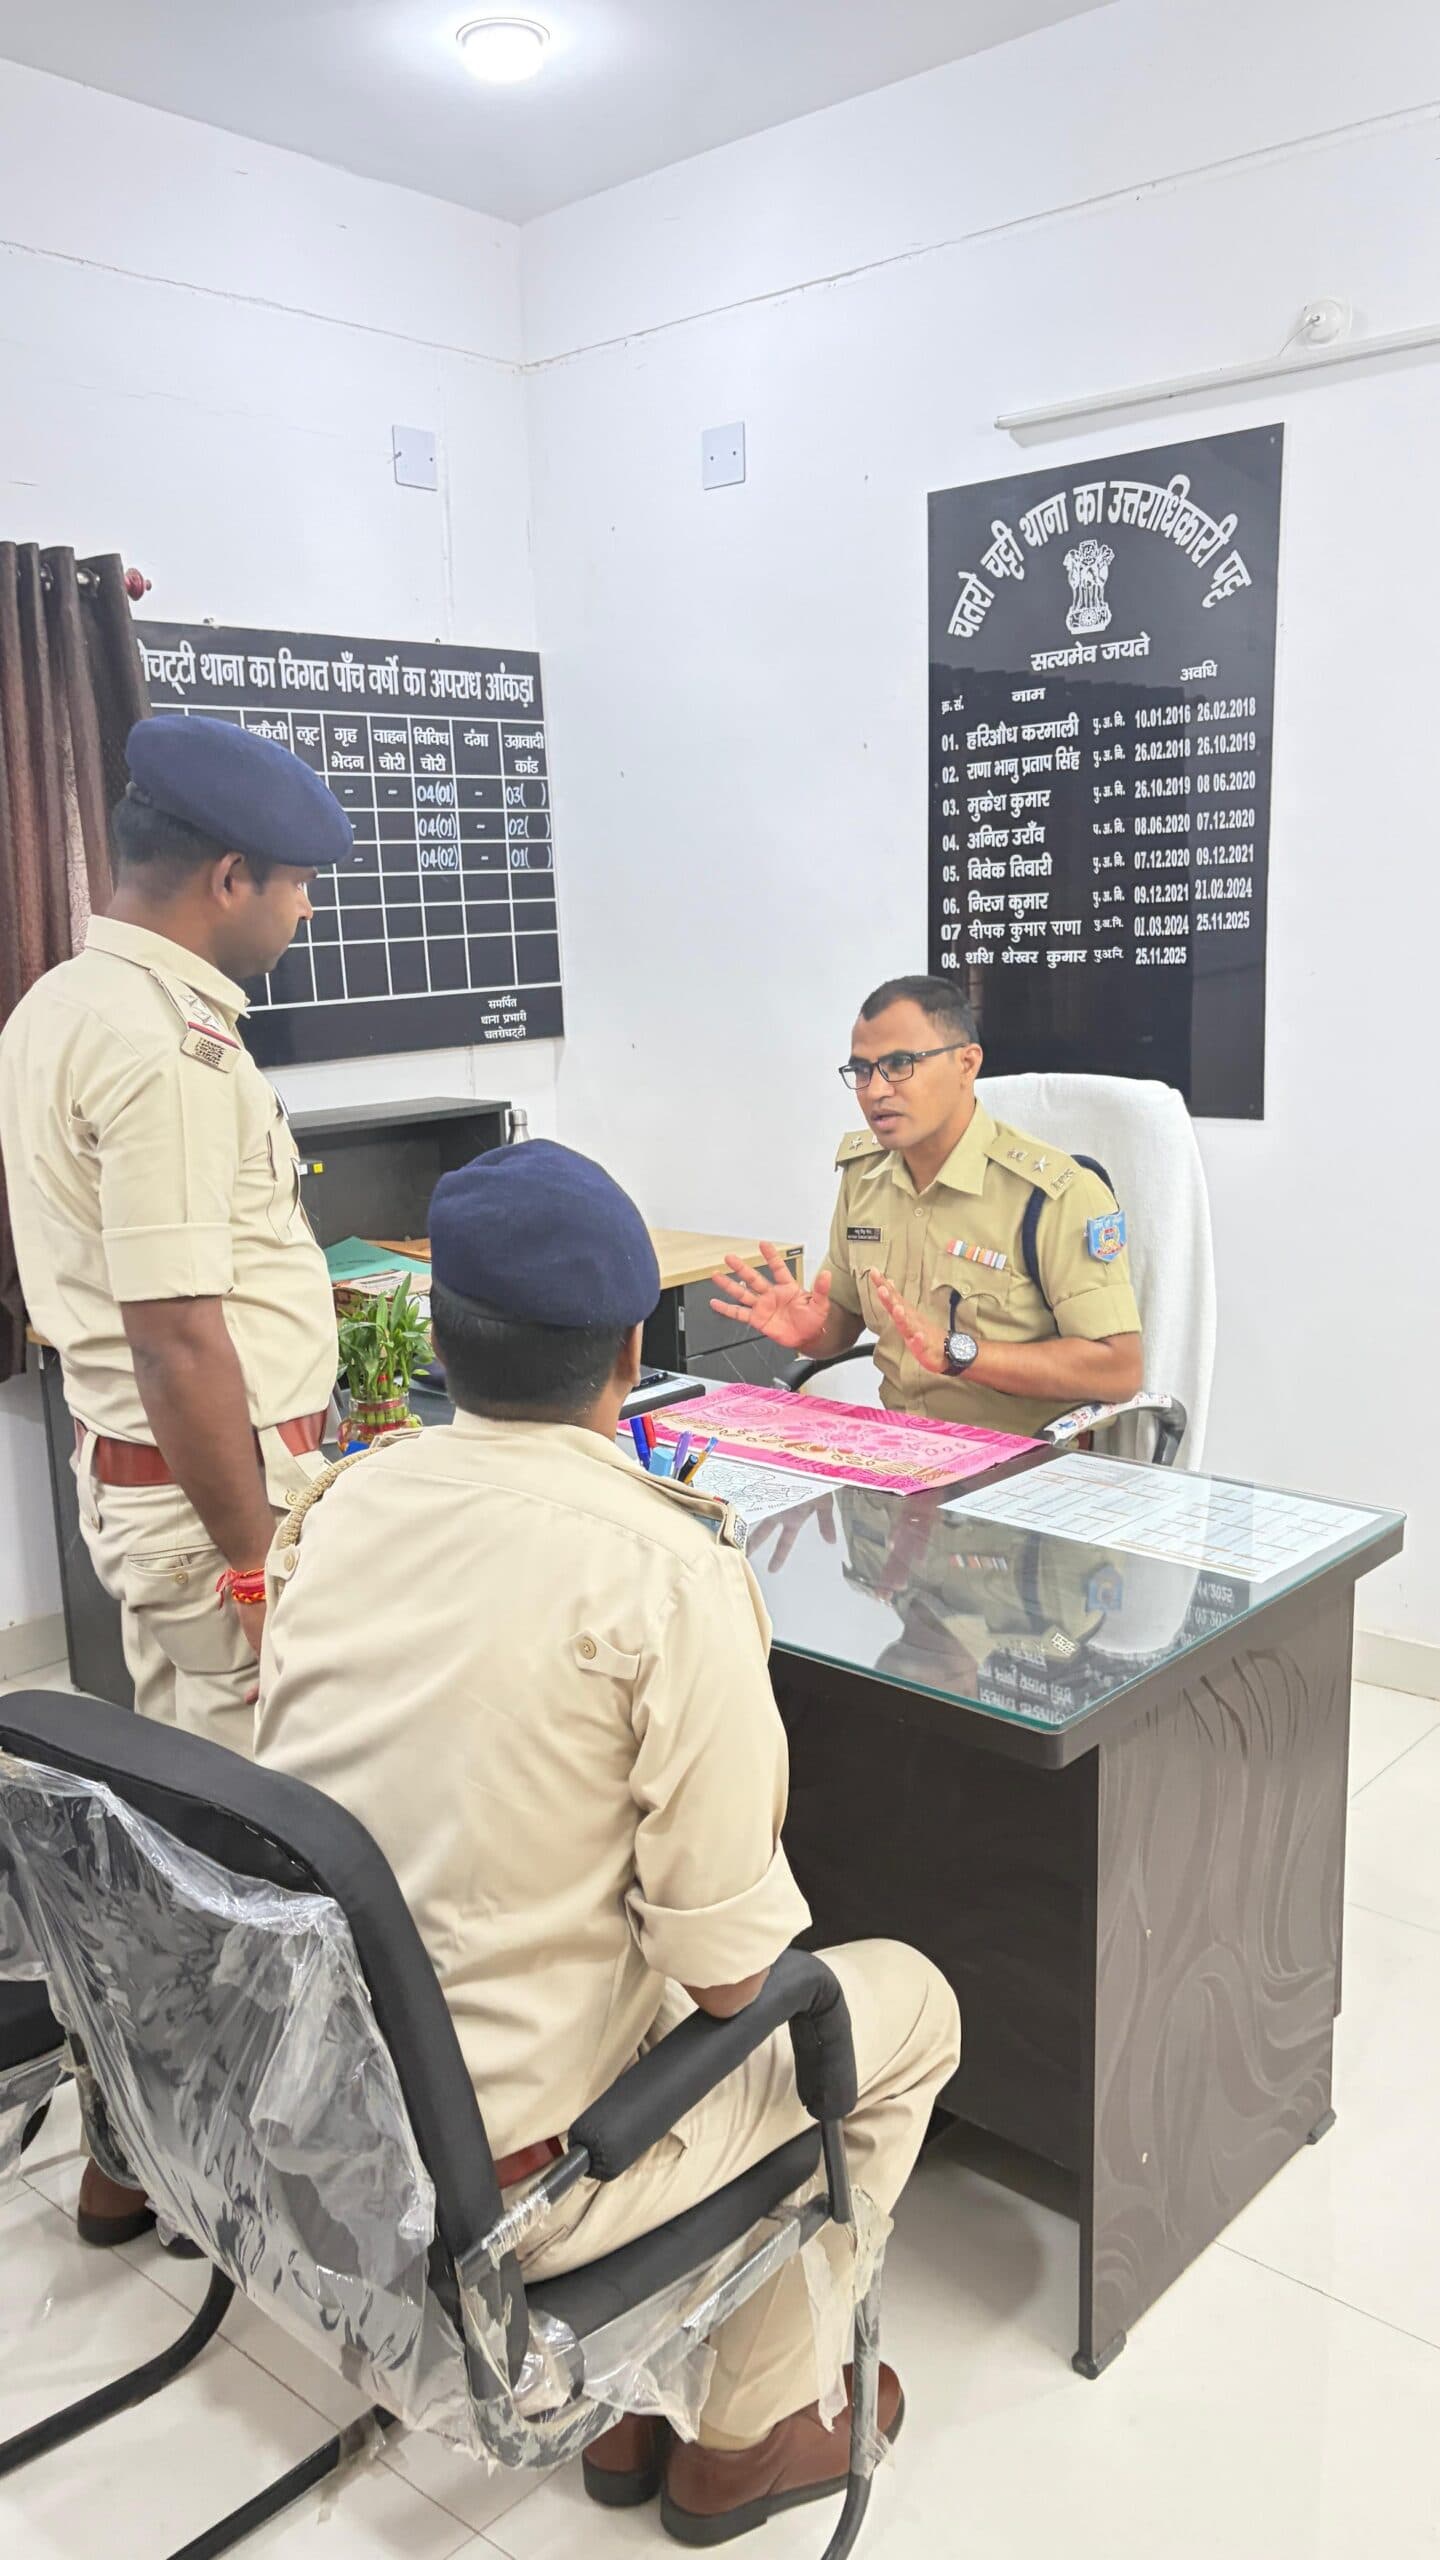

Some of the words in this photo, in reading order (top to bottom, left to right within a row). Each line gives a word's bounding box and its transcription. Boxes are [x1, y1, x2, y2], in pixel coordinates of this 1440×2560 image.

[947, 570, 996, 638] चतरो
[1019, 491, 1069, 547] थाना
[1072, 481, 1108, 526] का
[1107, 474, 1239, 570] उत्तराधिकारी
[1030, 641, 1098, 672] सत्यमेव
[1099, 630, 1151, 660] जयते
[199, 653, 245, 687] थाना
[247, 655, 276, 689] का
[277, 647, 331, 692] विगत
[331, 650, 367, 694] पाँच
[401, 666, 427, 697] का
[429, 668, 482, 700] अपराध
[1011, 687, 1046, 702] नाम
[1179, 659, 1218, 681] अवधि
[296, 726, 320, 747] लूट
[333, 727, 359, 748] गृह
[373, 729, 407, 745] वाहन
[413, 727, 450, 746] विविध
[463, 728, 489, 747] दंगा
[504, 732, 545, 751] उग्रवादी
[941, 733, 959, 752] 01.
[966, 721, 1019, 750] हरिऔध
[1021, 711, 1080, 741] करमाली
[1135, 704, 1191, 729] 10.01.2016
[1197, 696, 1256, 722] 26.02.2018
[331, 751, 365, 770] भेदन
[378, 752, 406, 771] चोरी
[420, 753, 447, 772] चोरी
[514, 755, 540, 774] कांड
[942, 766, 959, 784] 02.
[966, 761, 992, 780] राणा
[994, 758, 1020, 784] भानु
[1021, 754, 1053, 777] प्रताप
[1055, 745, 1081, 770] सिंह
[1134, 738, 1191, 762] 26.02.2018
[1197, 731, 1256, 756] 26.10.2019
[942, 798, 960, 817] 03.
[966, 789, 1007, 822] मुकेश
[1009, 789, 1052, 818] कुमार
[1134, 775, 1191, 799] 26.10.2019
[942, 834, 960, 852] 04.
[966, 824, 1010, 849] अनिल
[1134, 813, 1191, 836] 08.06.2020
[1196, 808, 1255, 831] 07.12.2020
[942, 865, 960, 882] 05.
[967, 857, 1007, 881] विवेक
[1009, 852, 1053, 878] तिवारी
[1134, 848, 1190, 869] 07.12.2020
[1196, 843, 1254, 866] 09.12.2021
[943, 897, 960, 915] 06.
[967, 889, 1005, 913] निरज
[1007, 892, 1050, 920] कुमार
[1134, 883, 1189, 904] 09.12.2021
[1194, 877, 1253, 900] 21.02.2024
[941, 923, 962, 941] 07
[967, 918, 1006, 940] दीपक
[1008, 921, 1047, 943] कुमार
[1049, 920, 1082, 936] राणा
[1134, 914, 1189, 937] 01.03.2024
[1196, 910, 1250, 931] 25.11.2025
[941, 952, 960, 969] 08.
[965, 946, 994, 964] शशि
[1001, 946, 1039, 964] शेखर
[1046, 950, 1088, 969] कुमार
[1135, 946, 1187, 965] 25.11.2025
